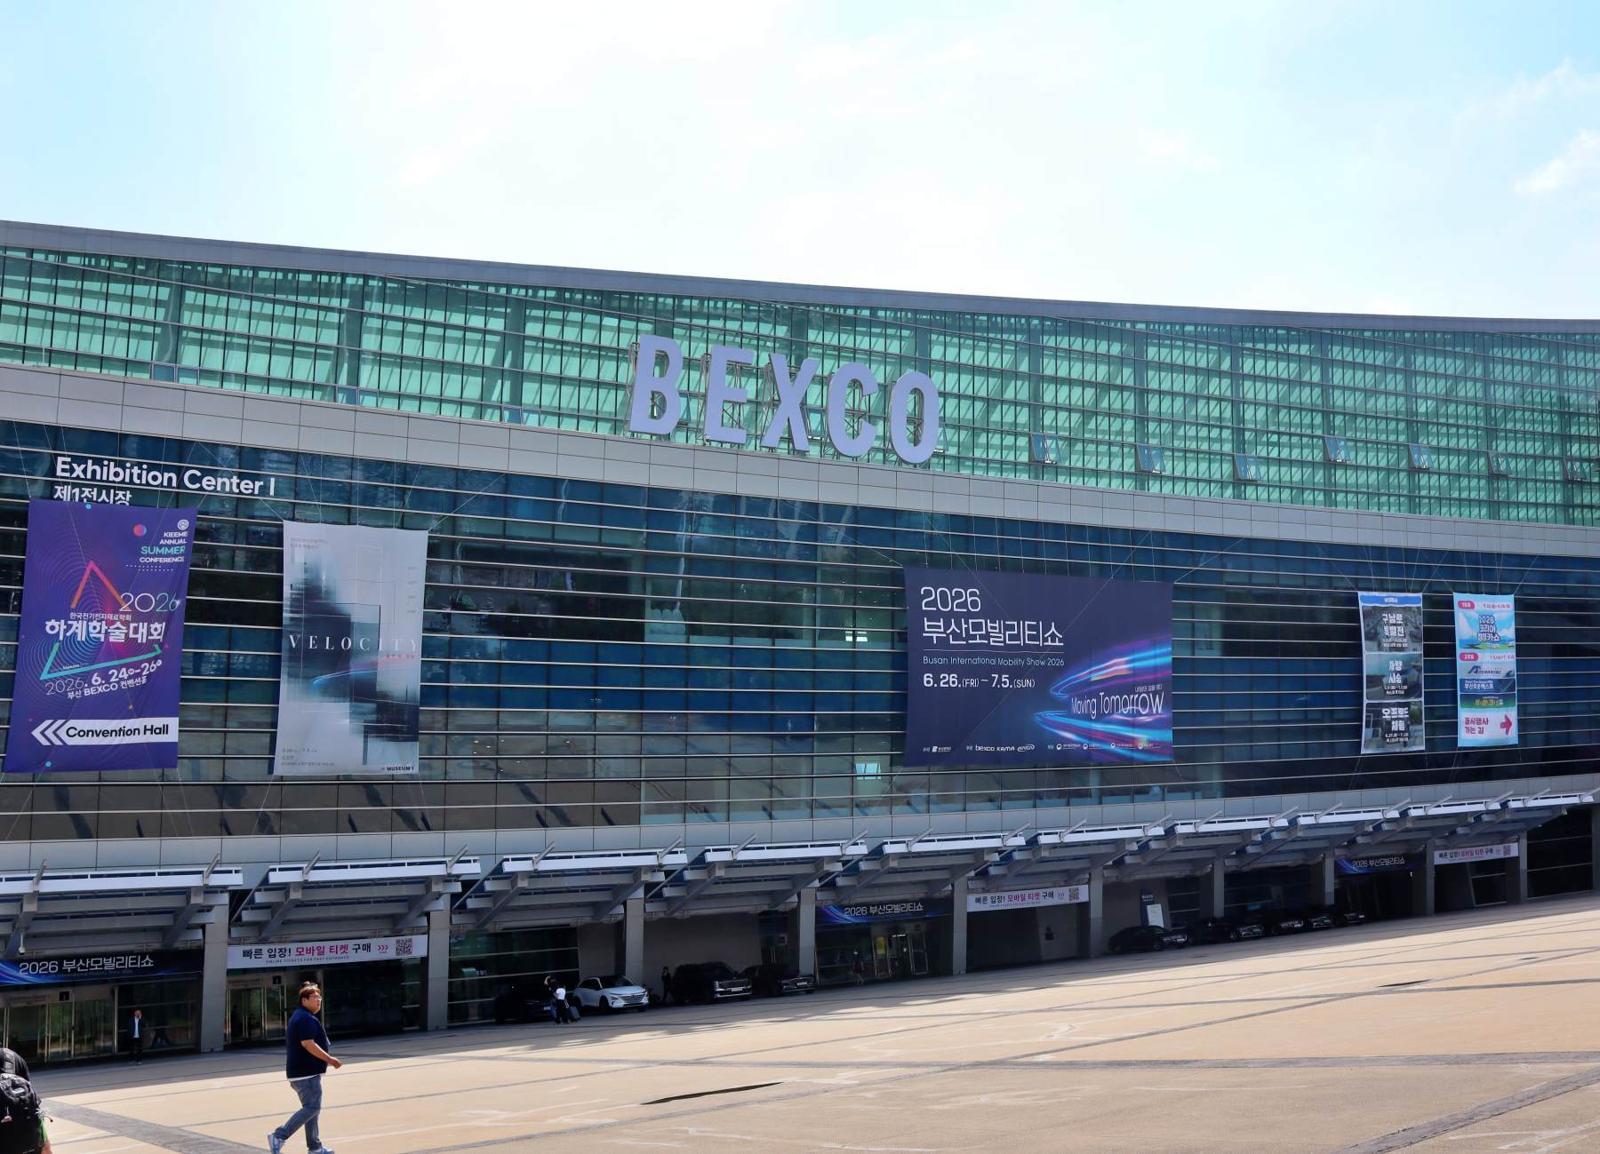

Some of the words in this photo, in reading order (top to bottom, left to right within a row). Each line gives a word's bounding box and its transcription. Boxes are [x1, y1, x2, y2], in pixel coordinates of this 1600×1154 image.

[629, 334, 940, 464] BEXCO
[55, 456, 177, 487] Exhibition
[183, 469, 263, 495] Center
[140, 545, 186, 555] SUMMER
[119, 592, 179, 612] 2026
[920, 586, 981, 612] 2026
[45, 619, 166, 643] 하계학술대회
[922, 617, 1065, 646] 부산모빌리티쇼
[923, 655, 949, 665] Busan
[950, 656, 995, 666] International
[997, 657, 1026, 668] Mobility
[1026, 657, 1046, 666] Show
[1047, 657, 1065, 666] 2026
[84, 683, 118, 696] BEXCO
[66, 726, 140, 738] Convention
[143, 724, 169, 735] Hall
[844, 906, 868, 917] 2026
[242, 948, 264, 959] 빠른
[267, 947, 292, 958] 입장!
[295, 945, 325, 957] 모바일
[329, 944, 349, 955] 티켓
[352, 942, 371, 953] 구매
[19, 961, 59, 975] 2026
[62, 955, 154, 972] 부산모빌리티쇼
